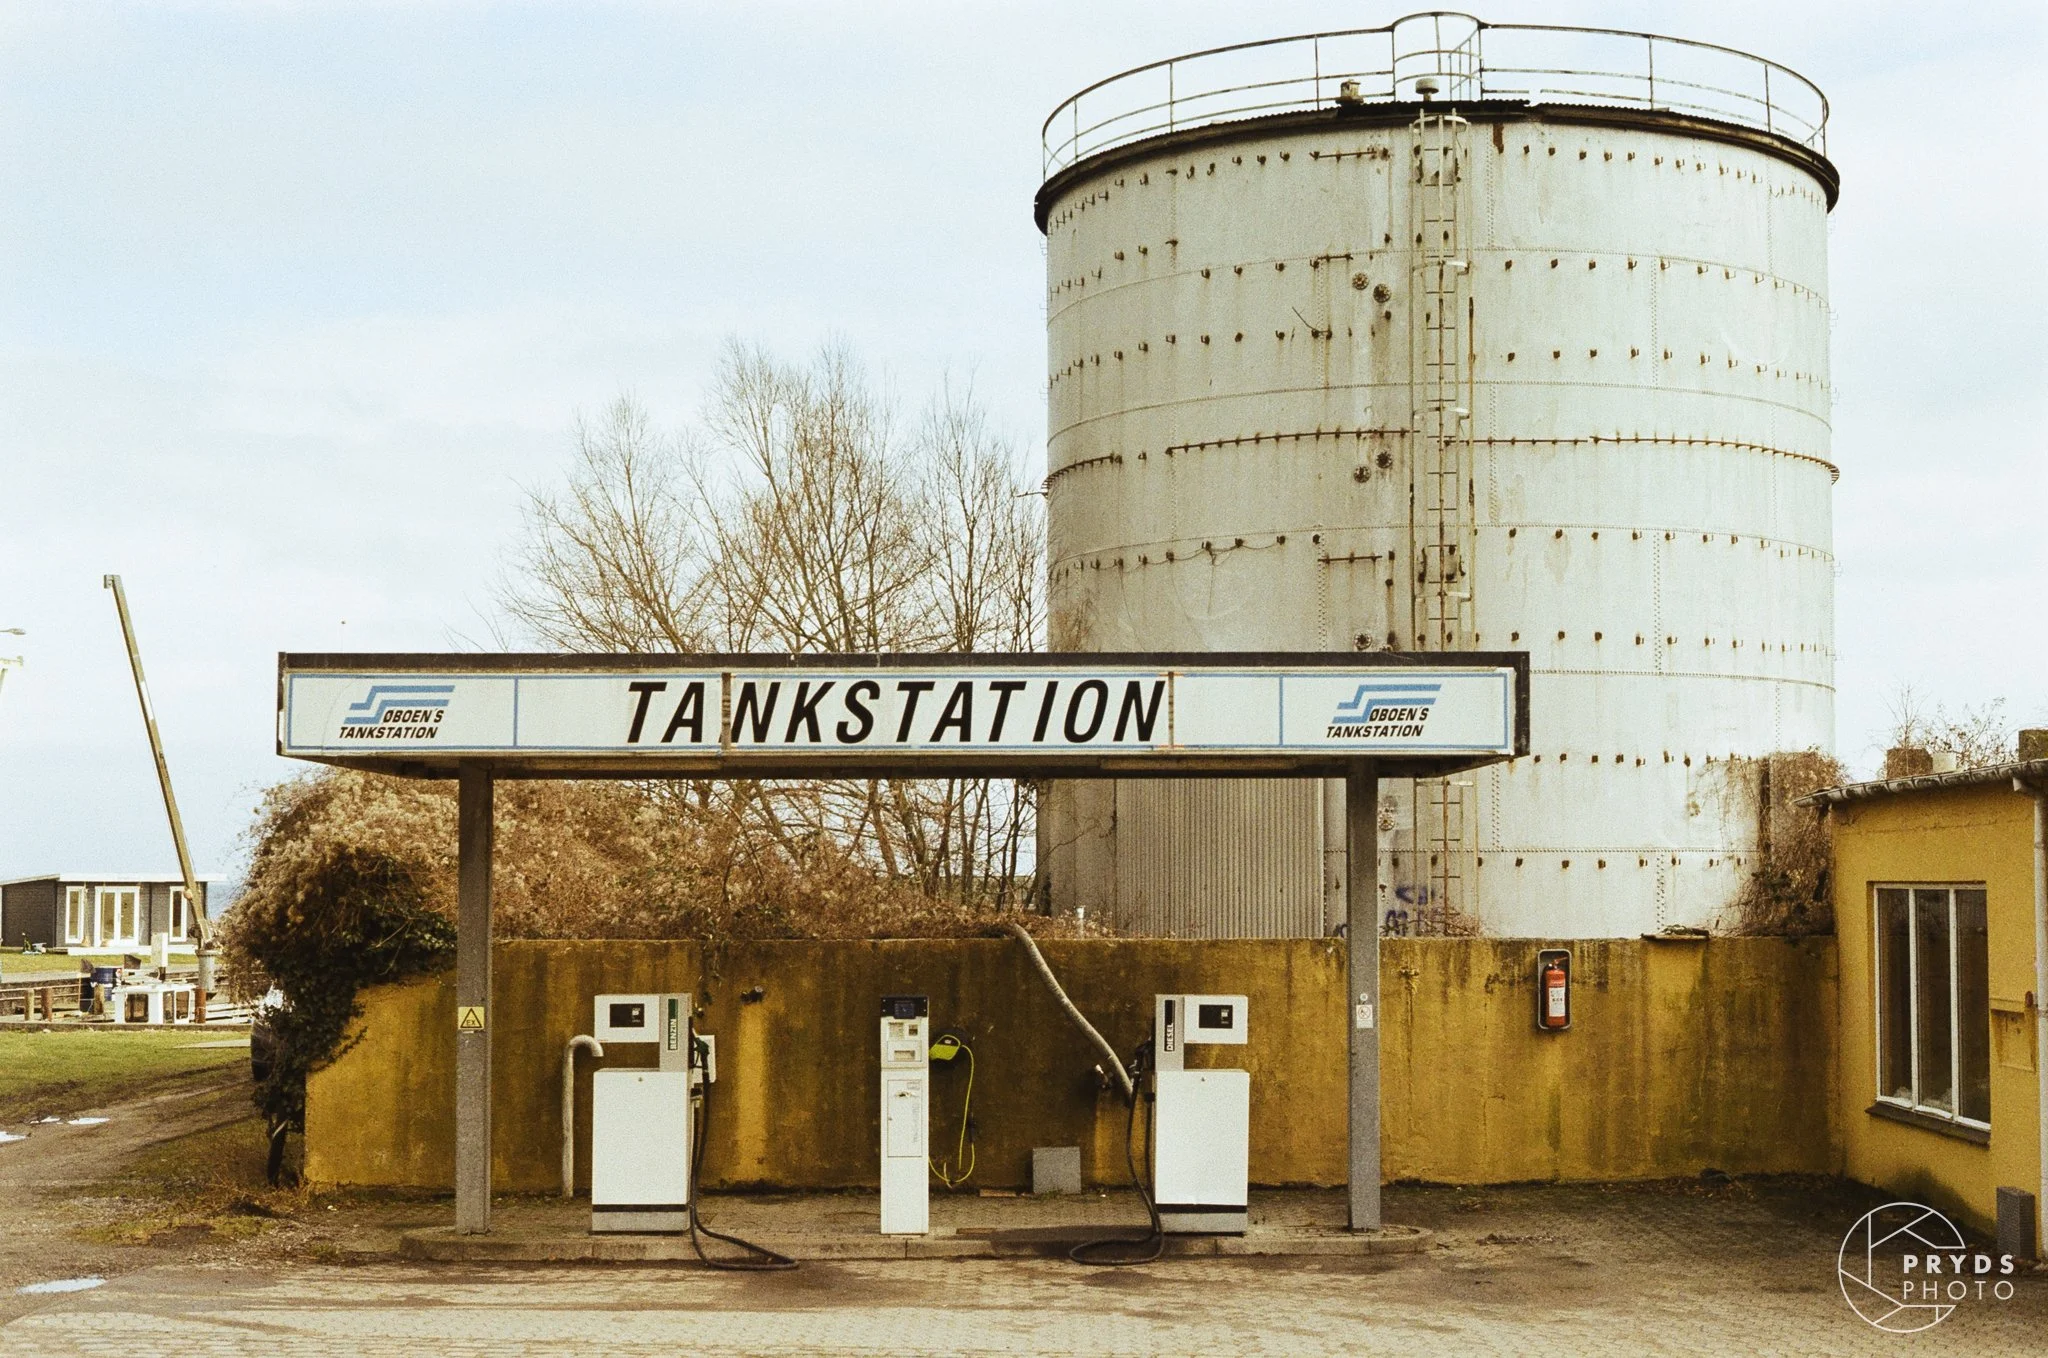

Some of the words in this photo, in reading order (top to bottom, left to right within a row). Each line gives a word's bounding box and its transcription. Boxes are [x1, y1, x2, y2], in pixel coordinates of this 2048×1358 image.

[627, 680, 1166, 744] TANKSTATION
[339, 726, 439, 739] TANKSTATION
[1326, 725, 1424, 739] TANKSTATION
[669, 1018, 677, 1050] BENZIN
[1166, 1022, 1174, 1051] DIESEL
